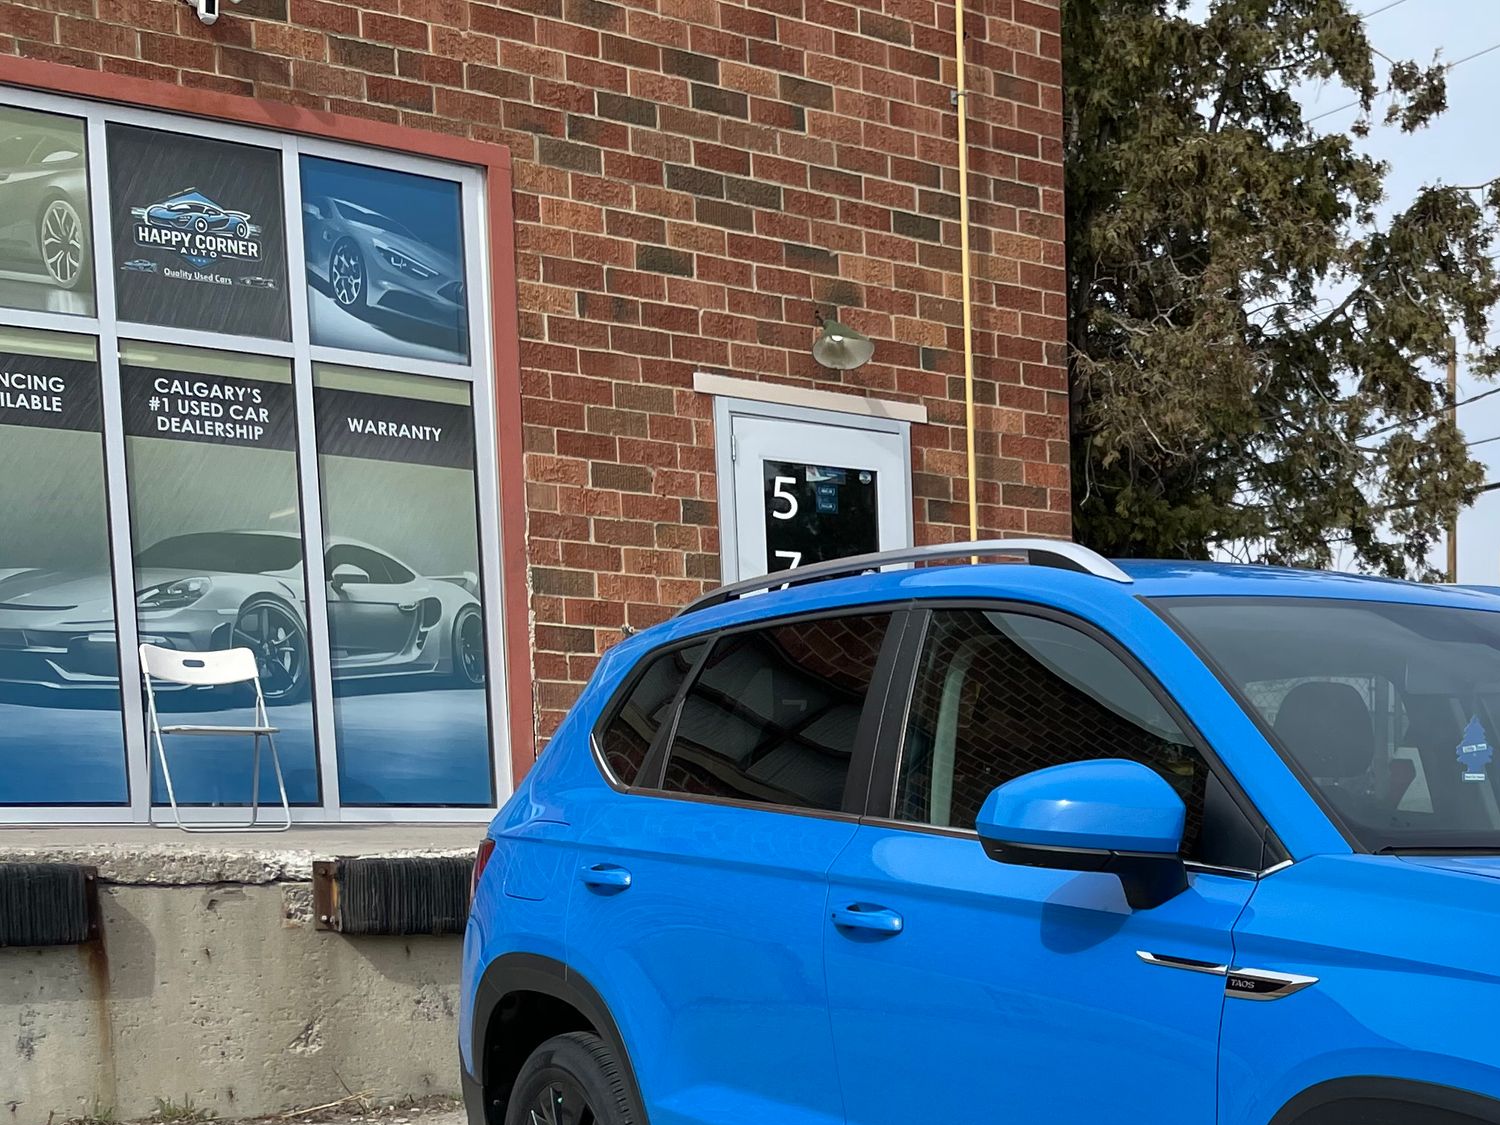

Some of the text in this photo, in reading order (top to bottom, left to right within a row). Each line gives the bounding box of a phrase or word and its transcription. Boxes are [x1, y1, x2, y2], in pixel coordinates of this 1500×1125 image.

[138, 226, 258, 258] HAPPY CORNER
[180, 246, 218, 258] AUTO
[163, 267, 233, 285] Quality Used Cars
[0, 372, 65, 393] NCING
[154, 378, 262, 403] CALGARY'S
[148, 396, 269, 423] #1 USED CAR
[157, 416, 264, 440] DEALERSHIP
[347, 417, 442, 442] WARRANTY
[772, 476, 798, 520] 5
[775, 550, 801, 590] 7
[1231, 979, 1255, 989] TAOS
